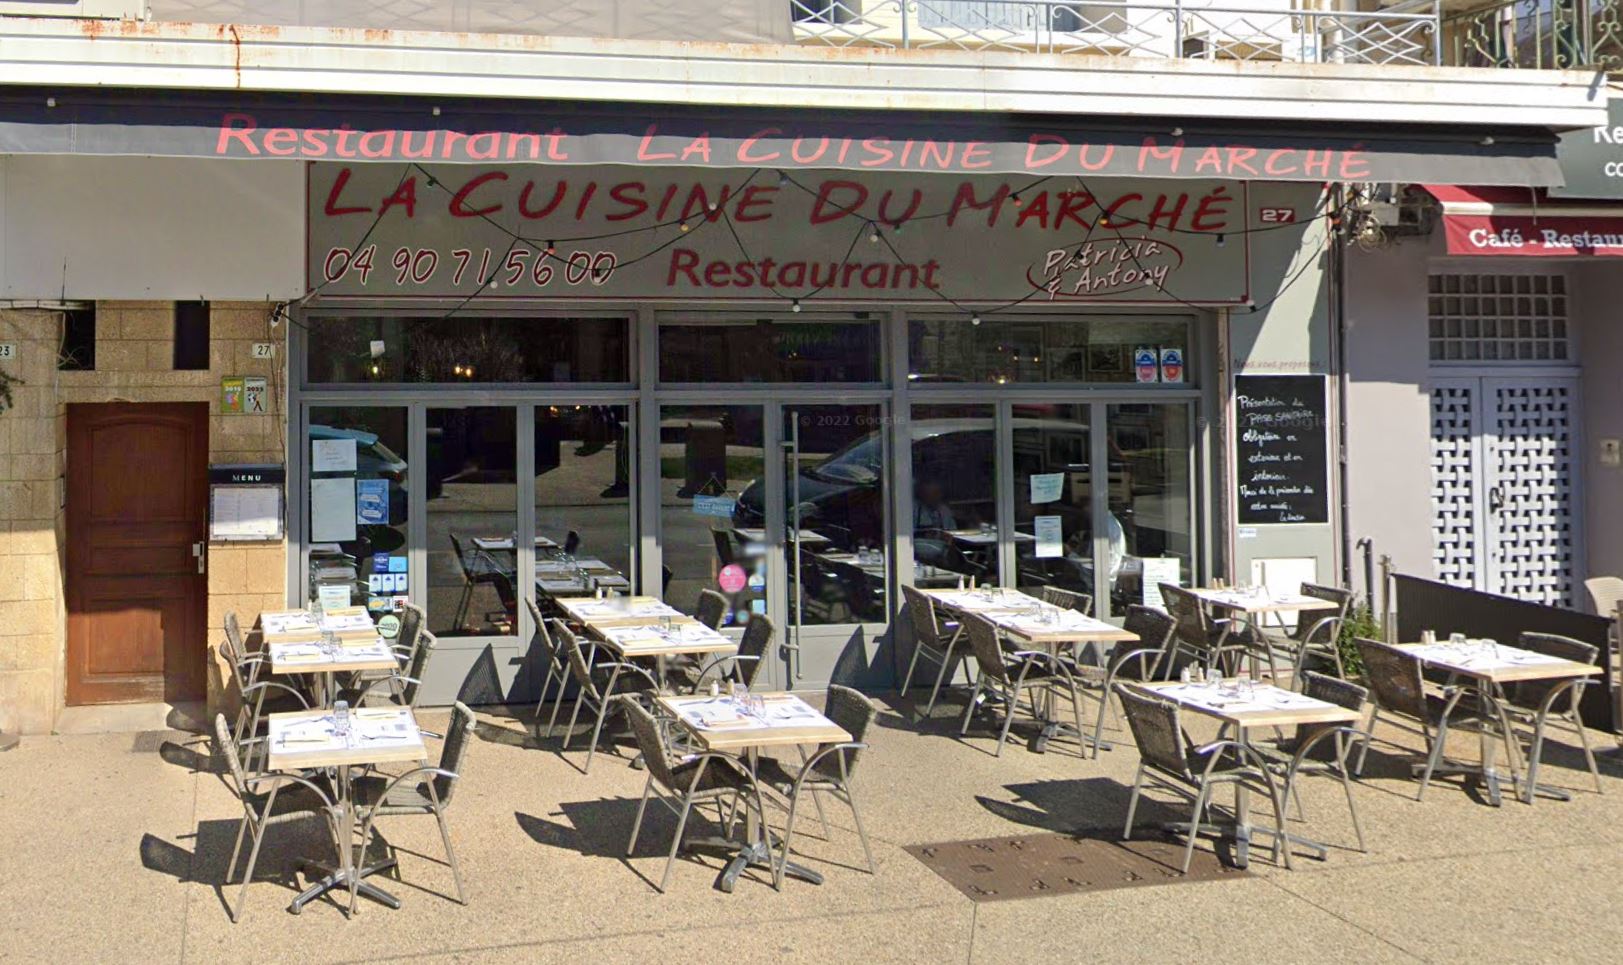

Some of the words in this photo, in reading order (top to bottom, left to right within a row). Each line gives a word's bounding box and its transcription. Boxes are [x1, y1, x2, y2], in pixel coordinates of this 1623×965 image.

[216, 113, 569, 160] Restaurant
[736, 128, 996, 169] CUISINE
[448, 171, 782, 224] CUISINE
[1260, 208, 1293, 223] 27
[1468, 227, 1524, 248] Café
[324, 244, 376, 285] 04
[392, 247, 439, 285] 90
[453, 248, 492, 286] 71
[505, 249, 554, 287] 56
[564, 250, 617, 287] 00
[666, 247, 942, 290] Restaurant
[1044, 235, 1162, 278] Patricia
[1074, 262, 1171, 292] Antony
[257, 345, 270, 356] 27
[232, 474, 262, 482] MENU
